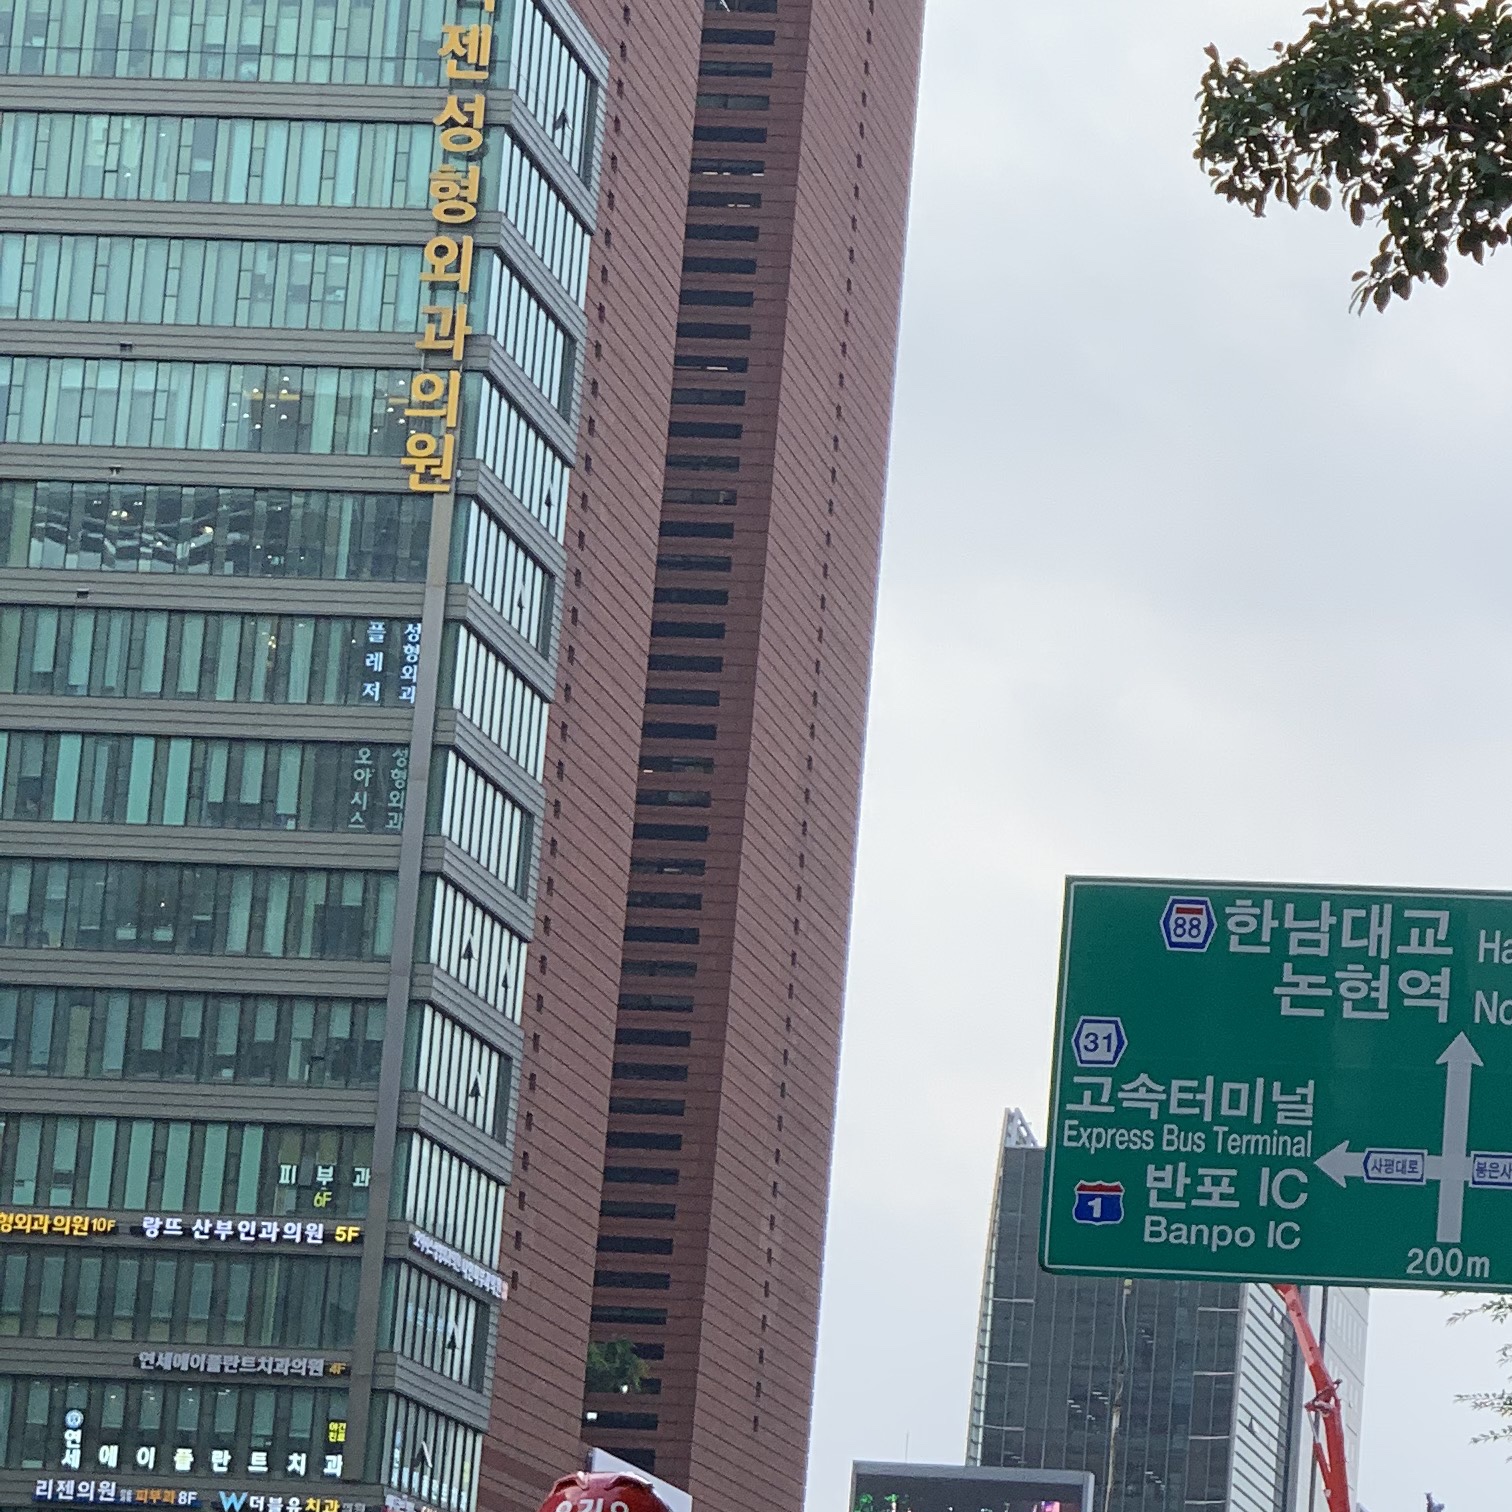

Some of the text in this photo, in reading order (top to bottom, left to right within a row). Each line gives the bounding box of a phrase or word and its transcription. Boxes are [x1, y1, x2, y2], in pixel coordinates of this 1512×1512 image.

[400, 0, 496, 493] 젠성형외과의원
[348, 747, 374, 829] 오아시스
[1173, 915, 1202, 939] 88
[1225, 898, 1454, 959] 한남대교
[1273, 962, 1451, 1024] 논현역
[1082, 1031, 1115, 1054] 31
[1065, 1072, 1316, 1127] 고속터미널
[1062, 1119, 1312, 1158] Express Bus Terminal
[1371, 1158, 1419, 1176] 사평대로
[313, 1190, 333, 1208] 6F
[1145, 1161, 1309, 1211] 반포 IC
[1088, 1196, 1103, 1218] 1
[142, 1216, 361, 1245] 랑뜨 산부인과의원 5F
[1143, 1214, 1301, 1252] Banpo IC
[1406, 1246, 1490, 1278] 200m
[36, 1479, 117, 1502] 리젠의원
[178, 1490, 199, 1506] 8F
